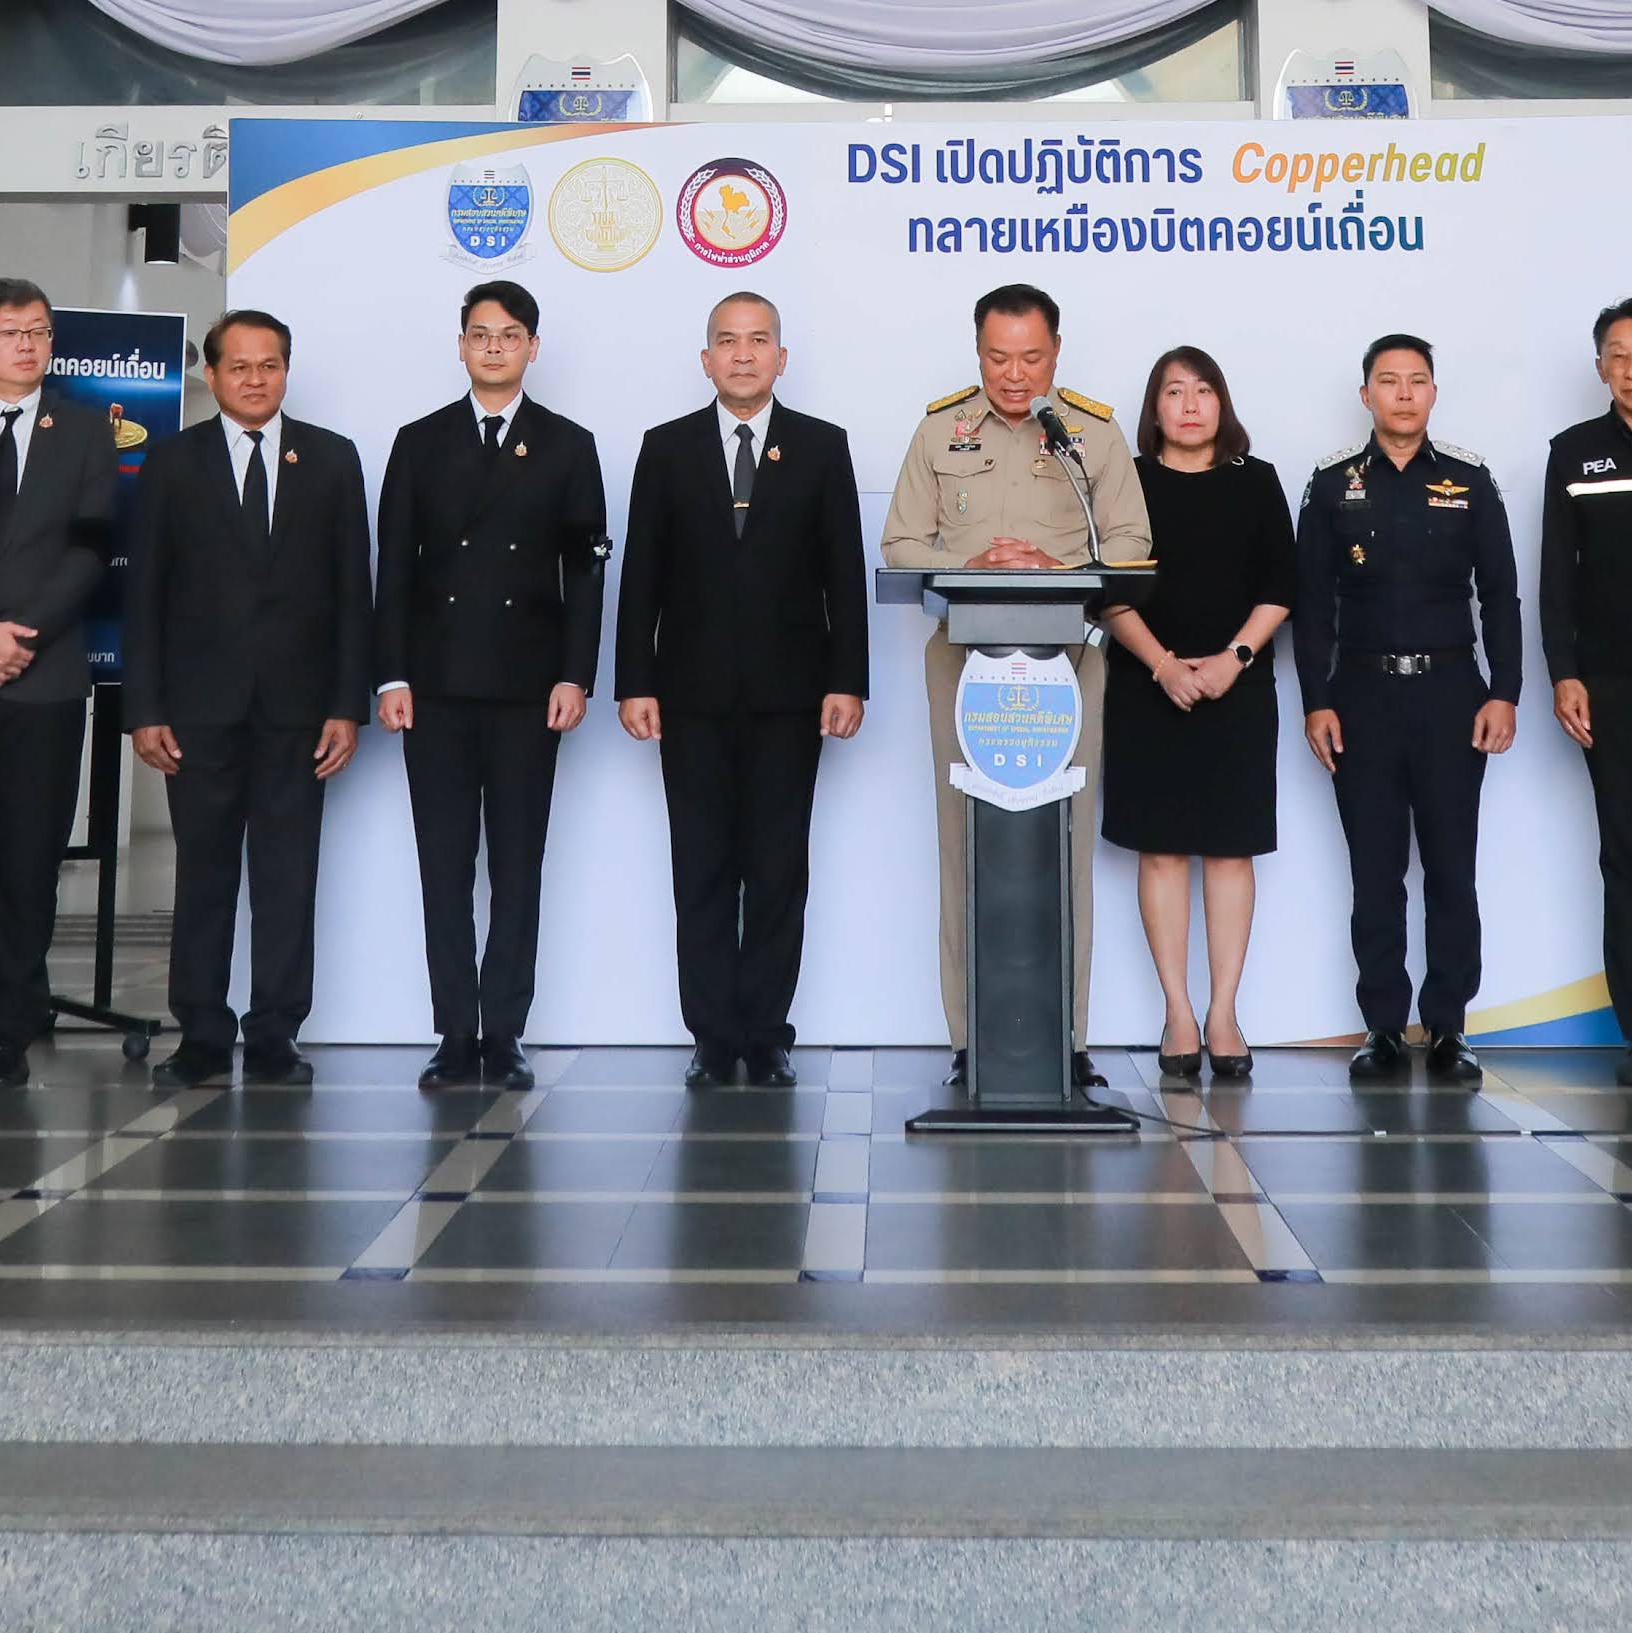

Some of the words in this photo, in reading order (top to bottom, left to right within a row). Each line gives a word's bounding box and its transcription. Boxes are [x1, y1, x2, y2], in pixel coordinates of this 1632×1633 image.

[847, 143, 921, 185] DSI
[935, 135, 1203, 195] เปิดปฏิบัติการ
[1232, 142, 1485, 193] Copperhead
[907, 188, 1425, 255] ทลายเหมืองบิตคอยน์เถื่อน
[469, 235, 507, 247] DSI
[1582, 457, 1617, 475] PEA
[993, 753, 1043, 768] DSI
